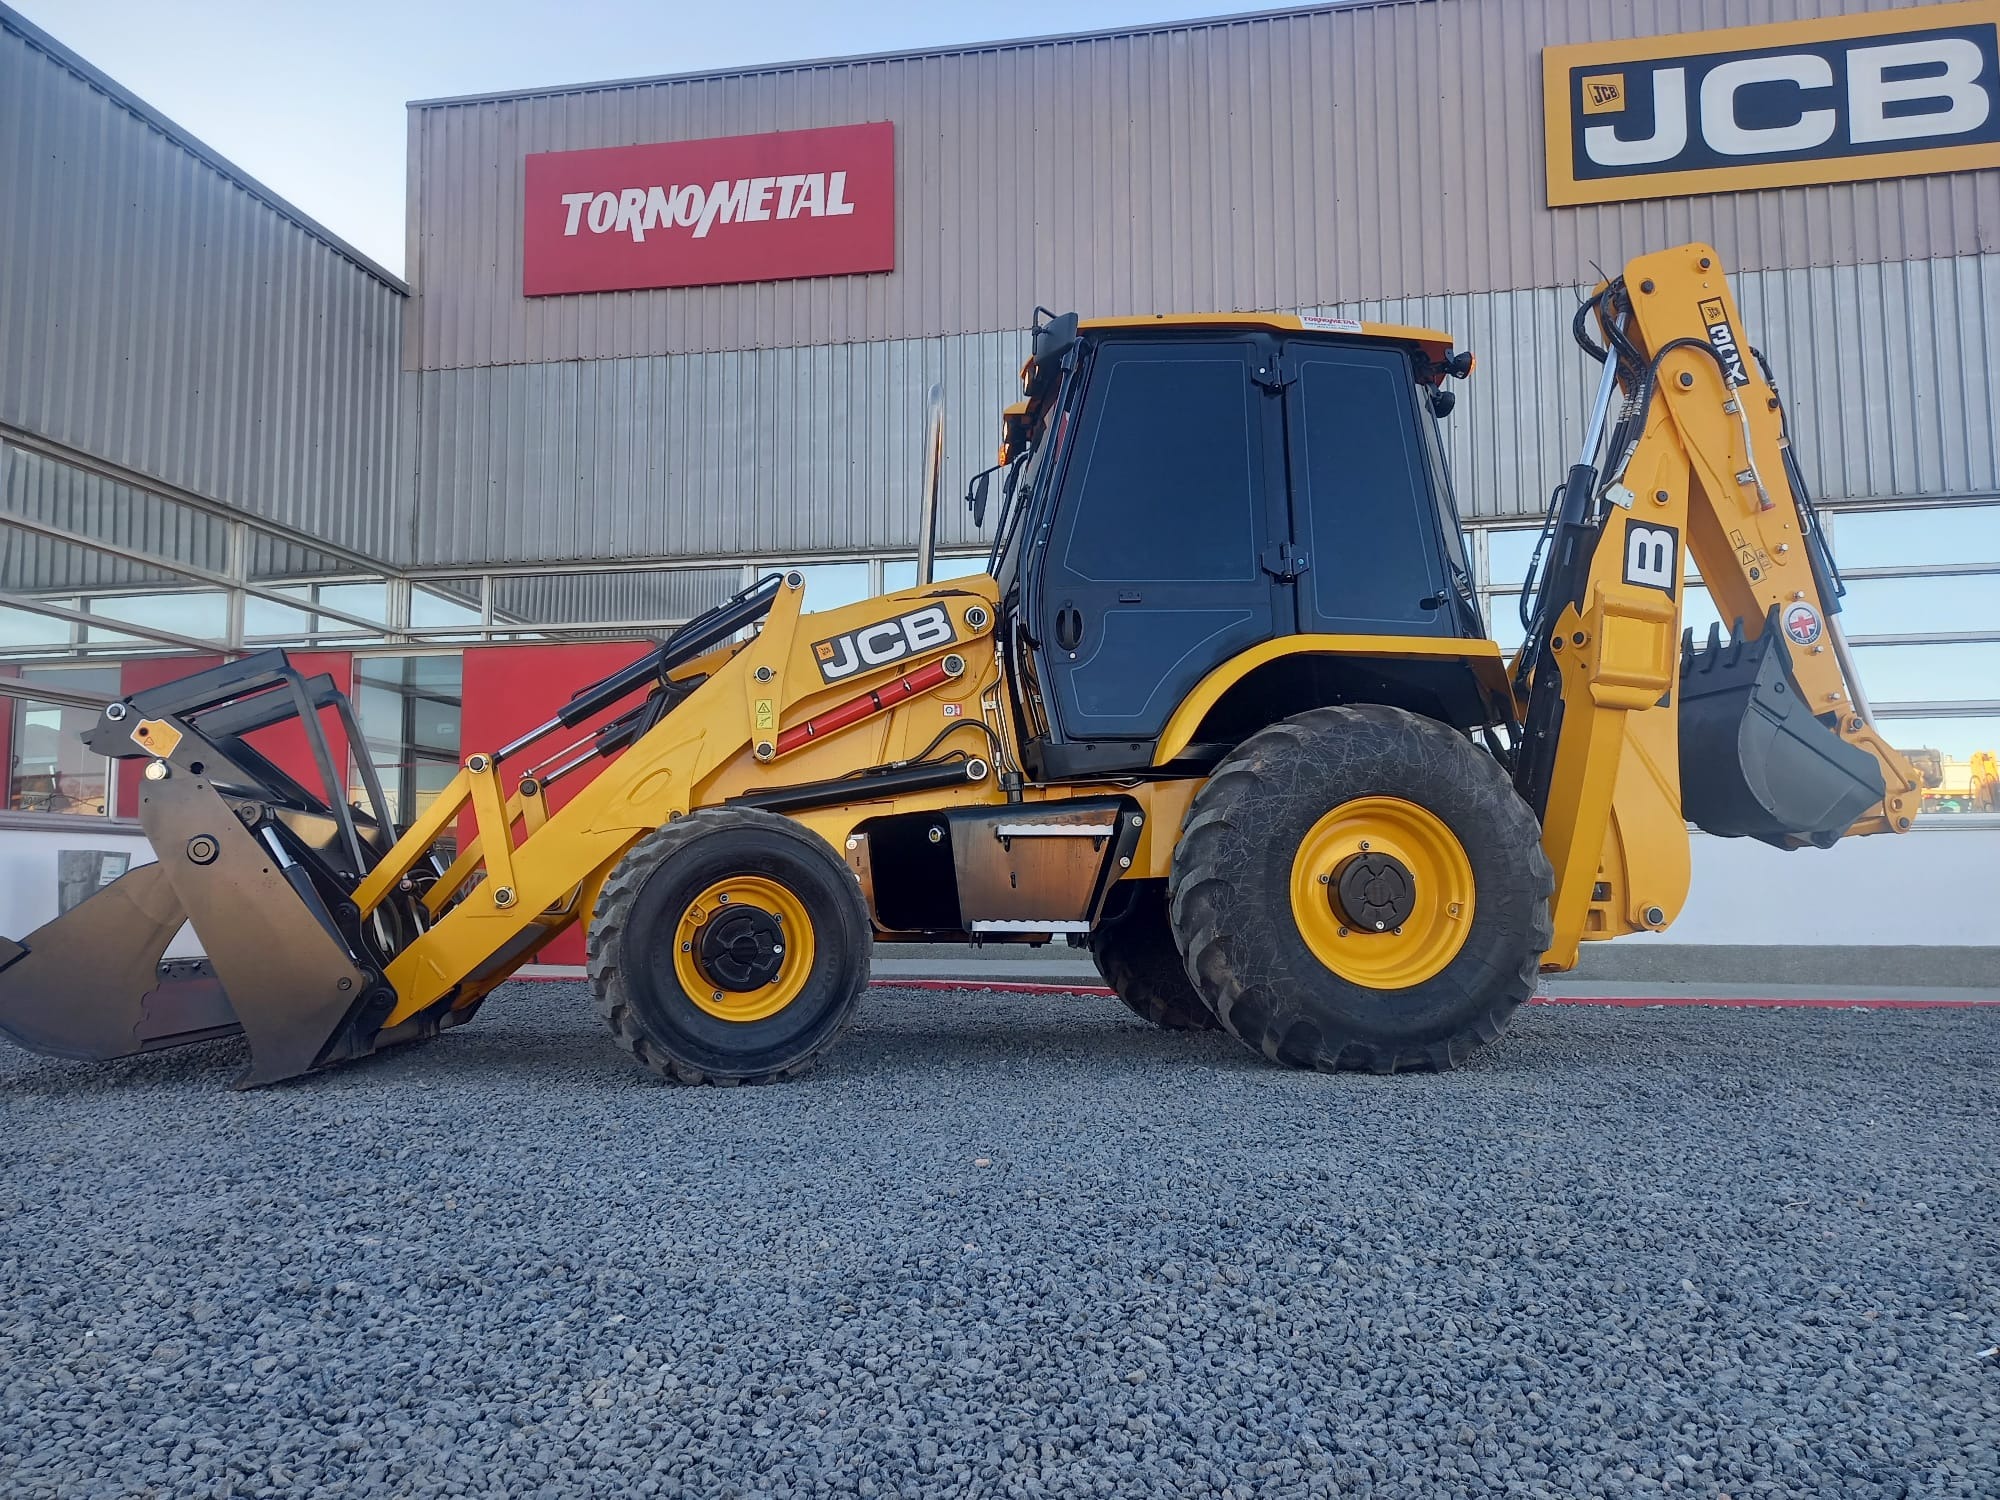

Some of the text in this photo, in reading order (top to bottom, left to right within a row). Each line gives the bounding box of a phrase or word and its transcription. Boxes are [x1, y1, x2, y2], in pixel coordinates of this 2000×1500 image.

[1584, 38, 1990, 166] JCB
[1593, 85, 1618, 103] JCB
[561, 171, 855, 243] TORNOMETAL
[822, 607, 952, 678] JCB
